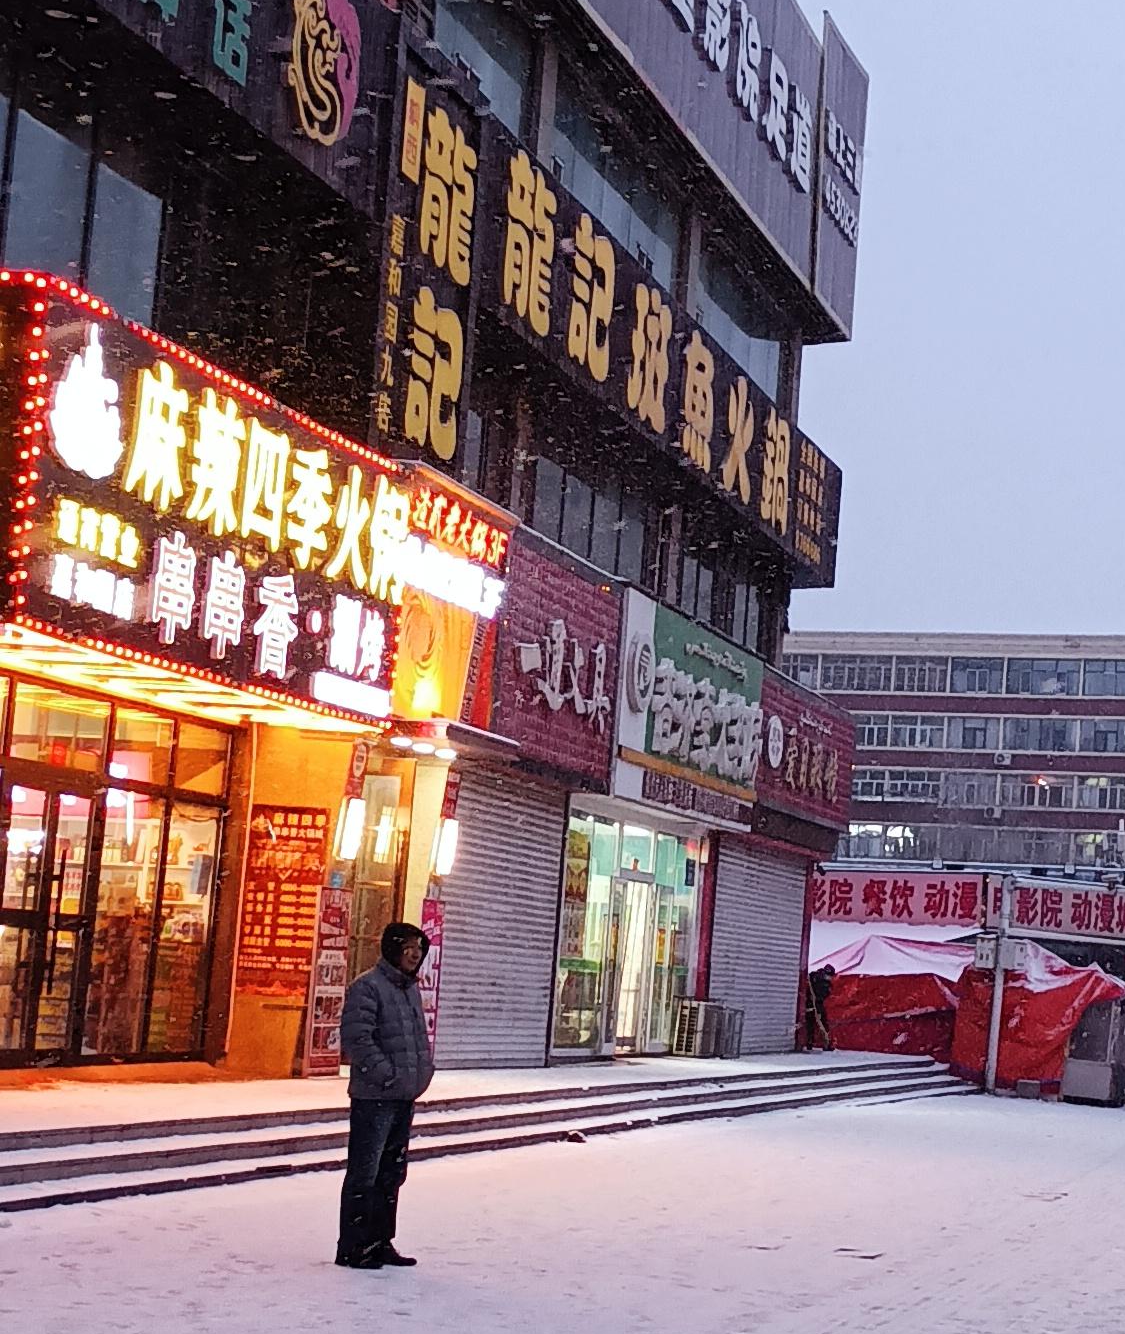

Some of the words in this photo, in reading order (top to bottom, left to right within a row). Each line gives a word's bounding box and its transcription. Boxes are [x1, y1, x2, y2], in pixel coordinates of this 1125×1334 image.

[123, 360, 411, 605] 麻辣四季火锅
[861, 878, 915, 919] 餐饮
[924, 880, 978, 920] 动漫
